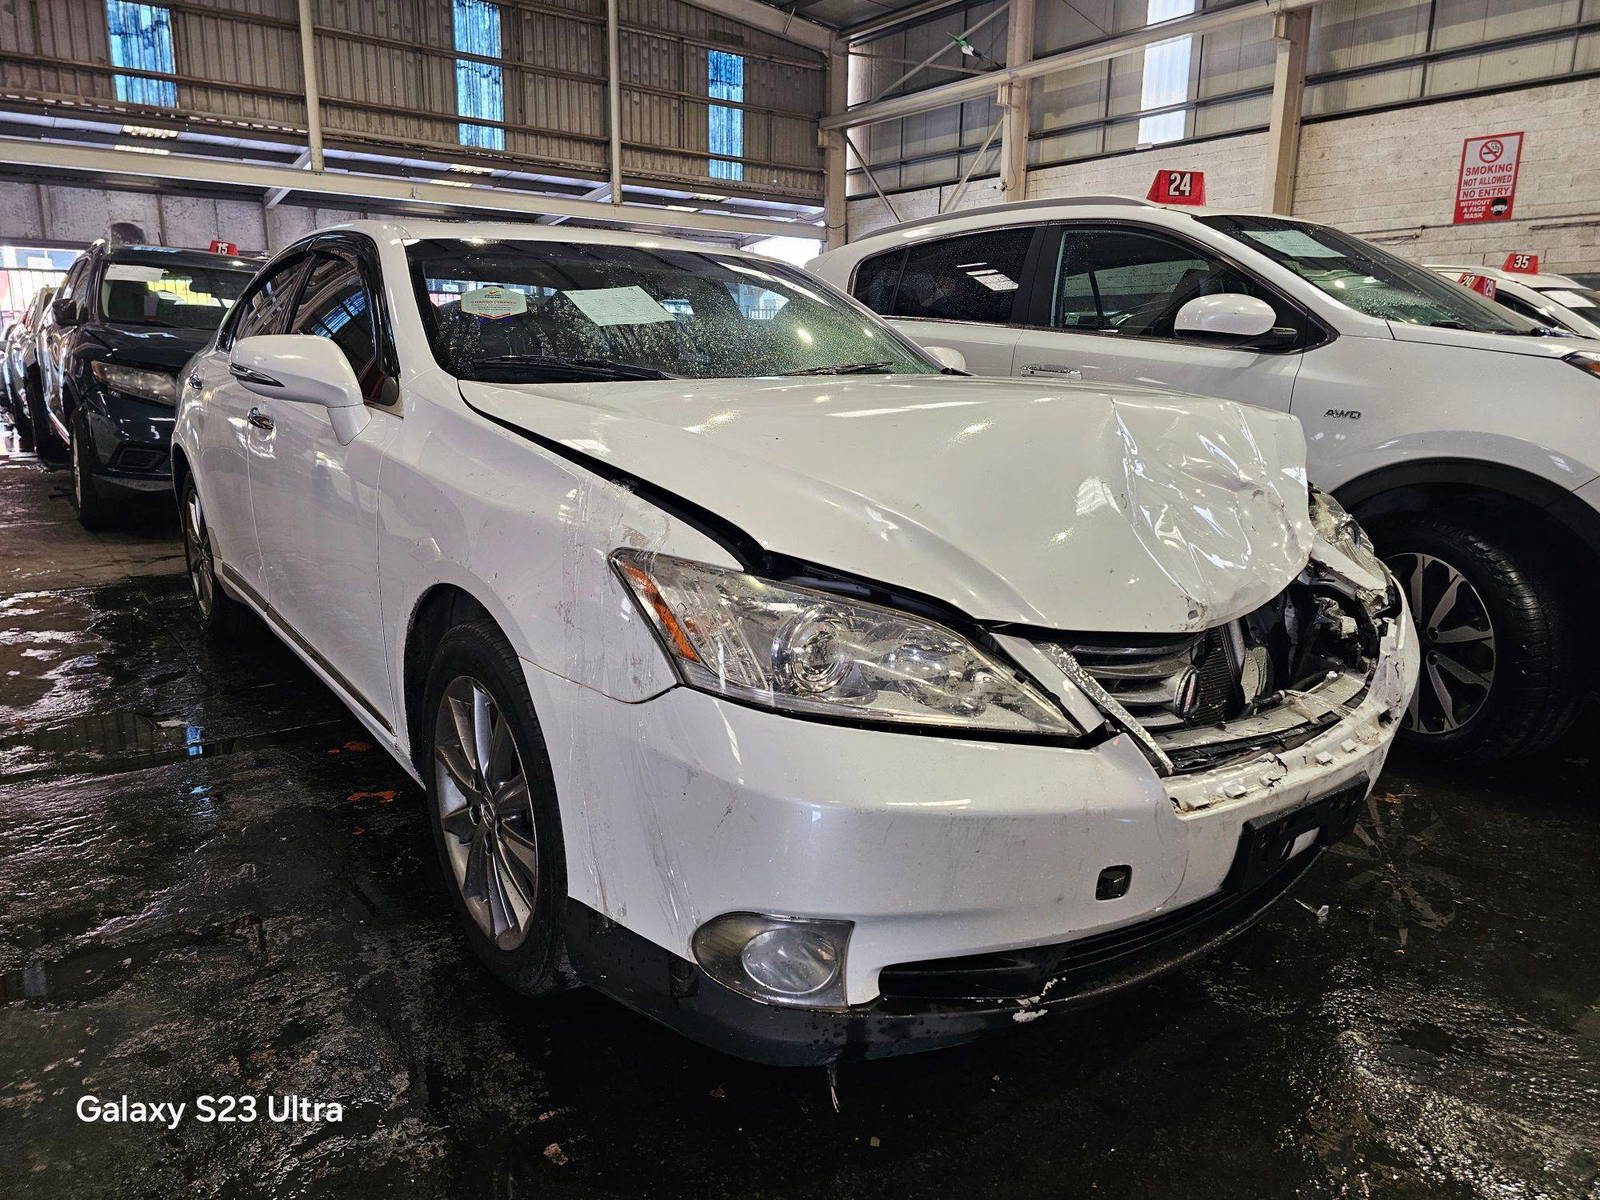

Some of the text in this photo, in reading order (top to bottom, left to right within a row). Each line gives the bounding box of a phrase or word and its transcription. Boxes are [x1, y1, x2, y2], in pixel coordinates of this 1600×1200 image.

[1465, 163, 1513, 176] SMOKING
[1168, 172, 1192, 196] 24
[1463, 175, 1512, 187] NOT ALLOWED
[1462, 187, 1510, 199] NO ENTRY
[1460, 199, 1491, 207] WITHOUT
[217, 242, 228, 255] 15
[1513, 255, 1530, 269] 35
[1323, 409, 1361, 419] AWD
